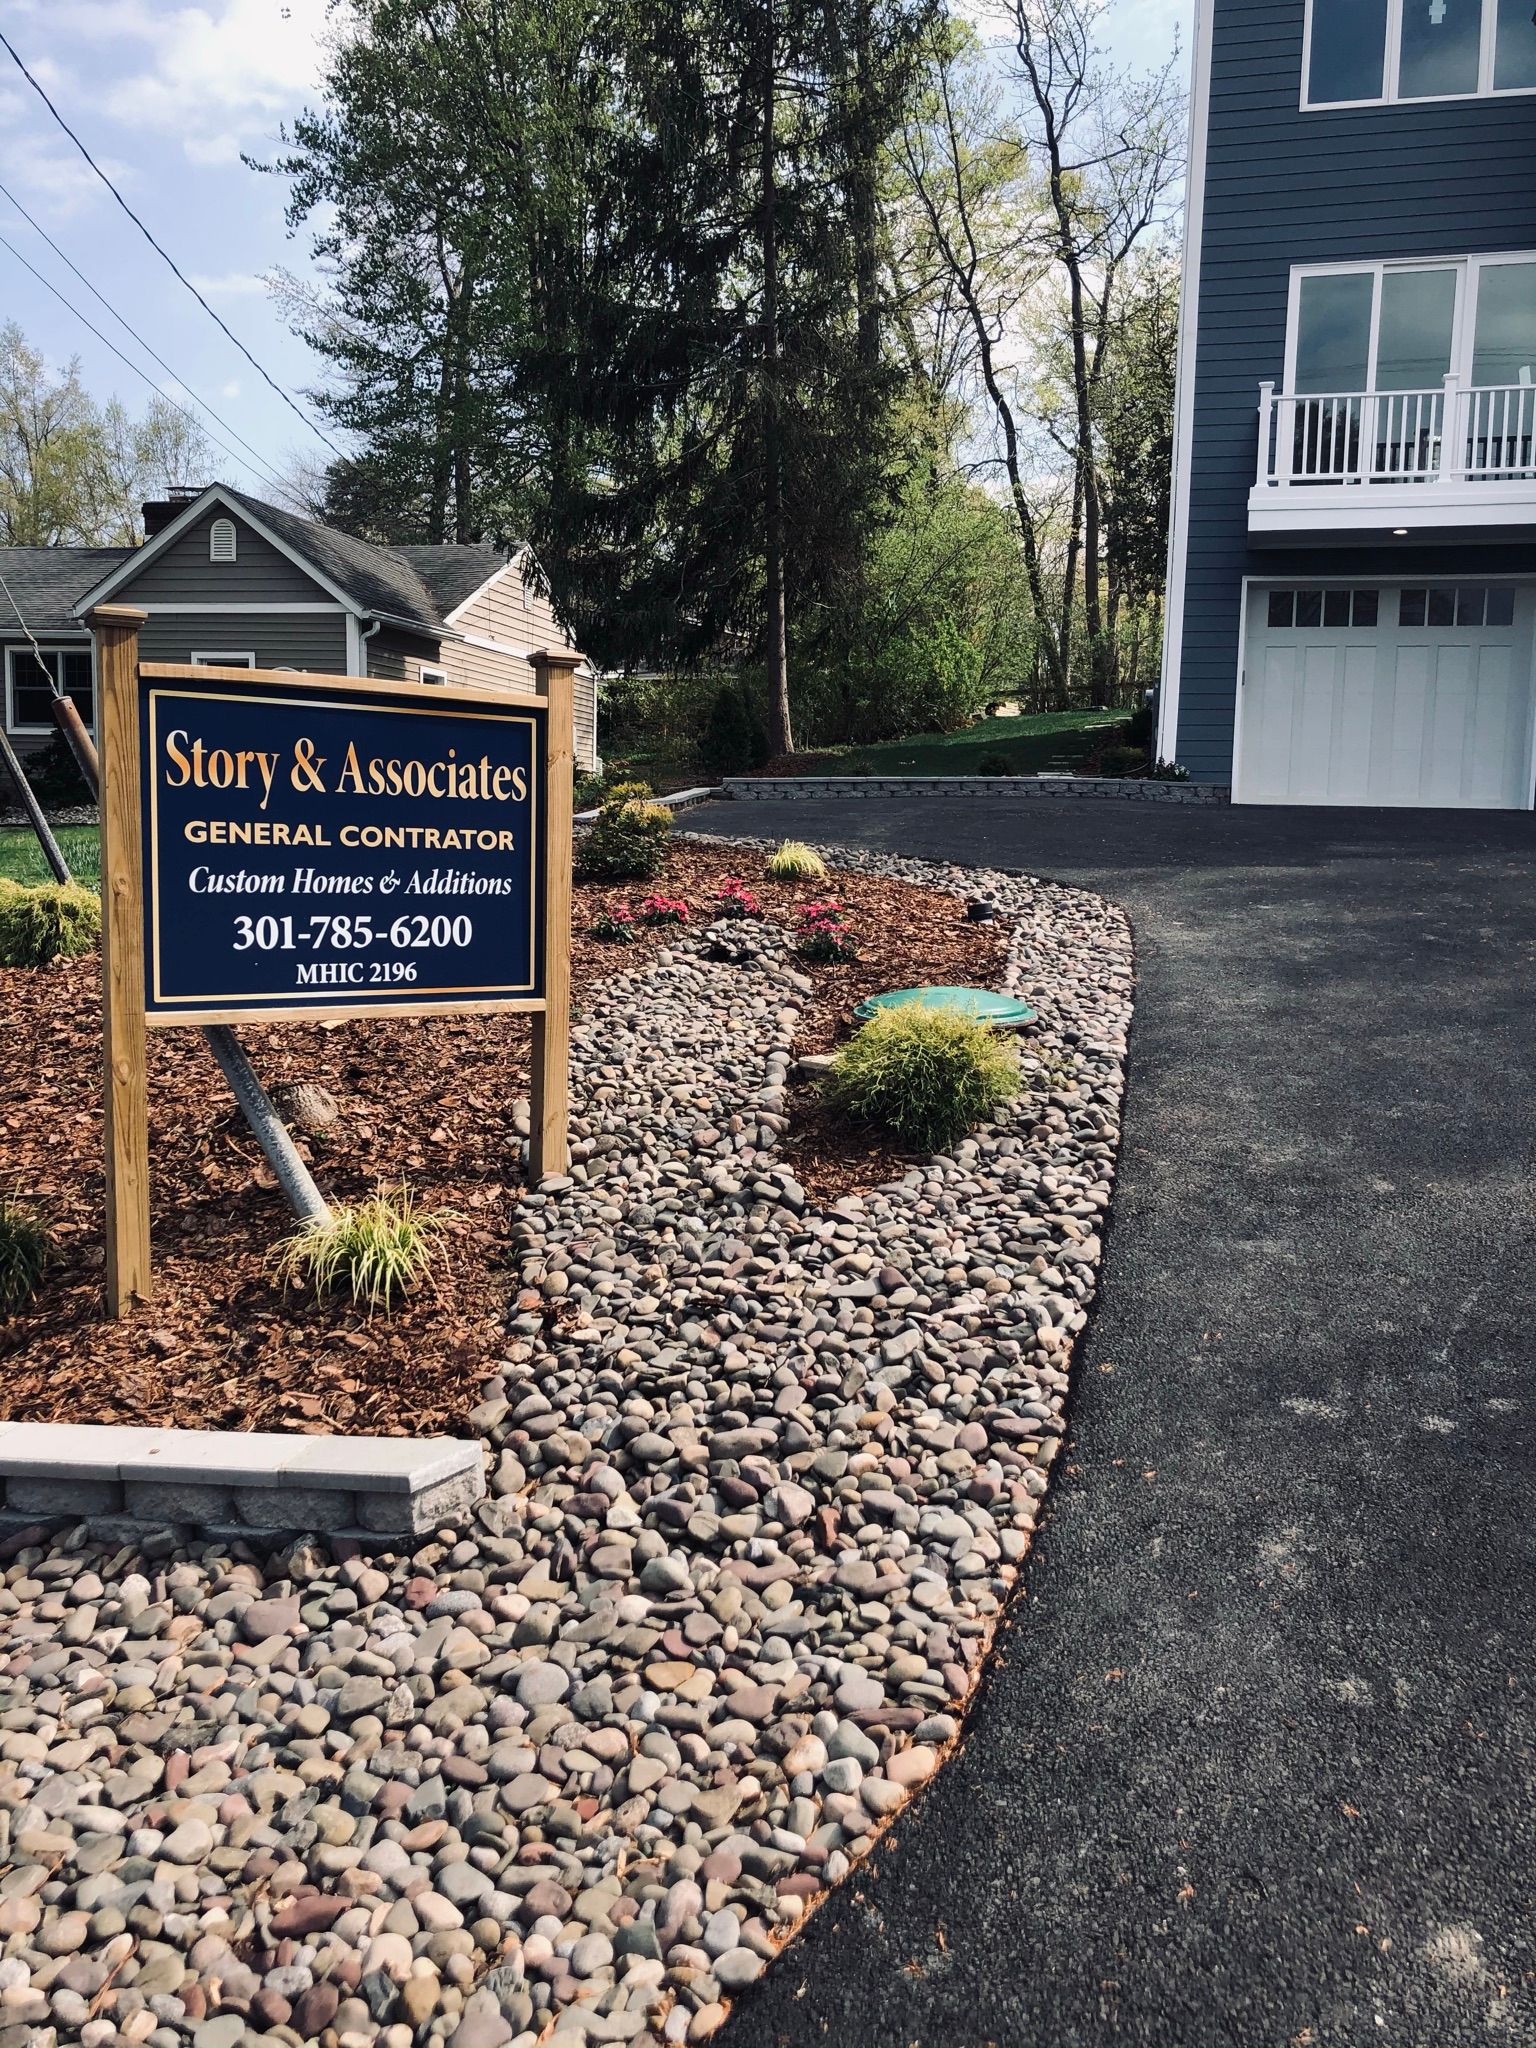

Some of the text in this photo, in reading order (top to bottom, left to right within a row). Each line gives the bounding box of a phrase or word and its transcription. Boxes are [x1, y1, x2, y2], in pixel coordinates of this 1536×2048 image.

[165, 729, 527, 810] Story & Associates
[184, 820, 515, 851] GENERAL CONTRATOR
[189, 866, 512, 896] Custom Homes & Additions
[232, 915, 473, 950] 301-785-6200
[295, 961, 418, 985] MHIC 2196
